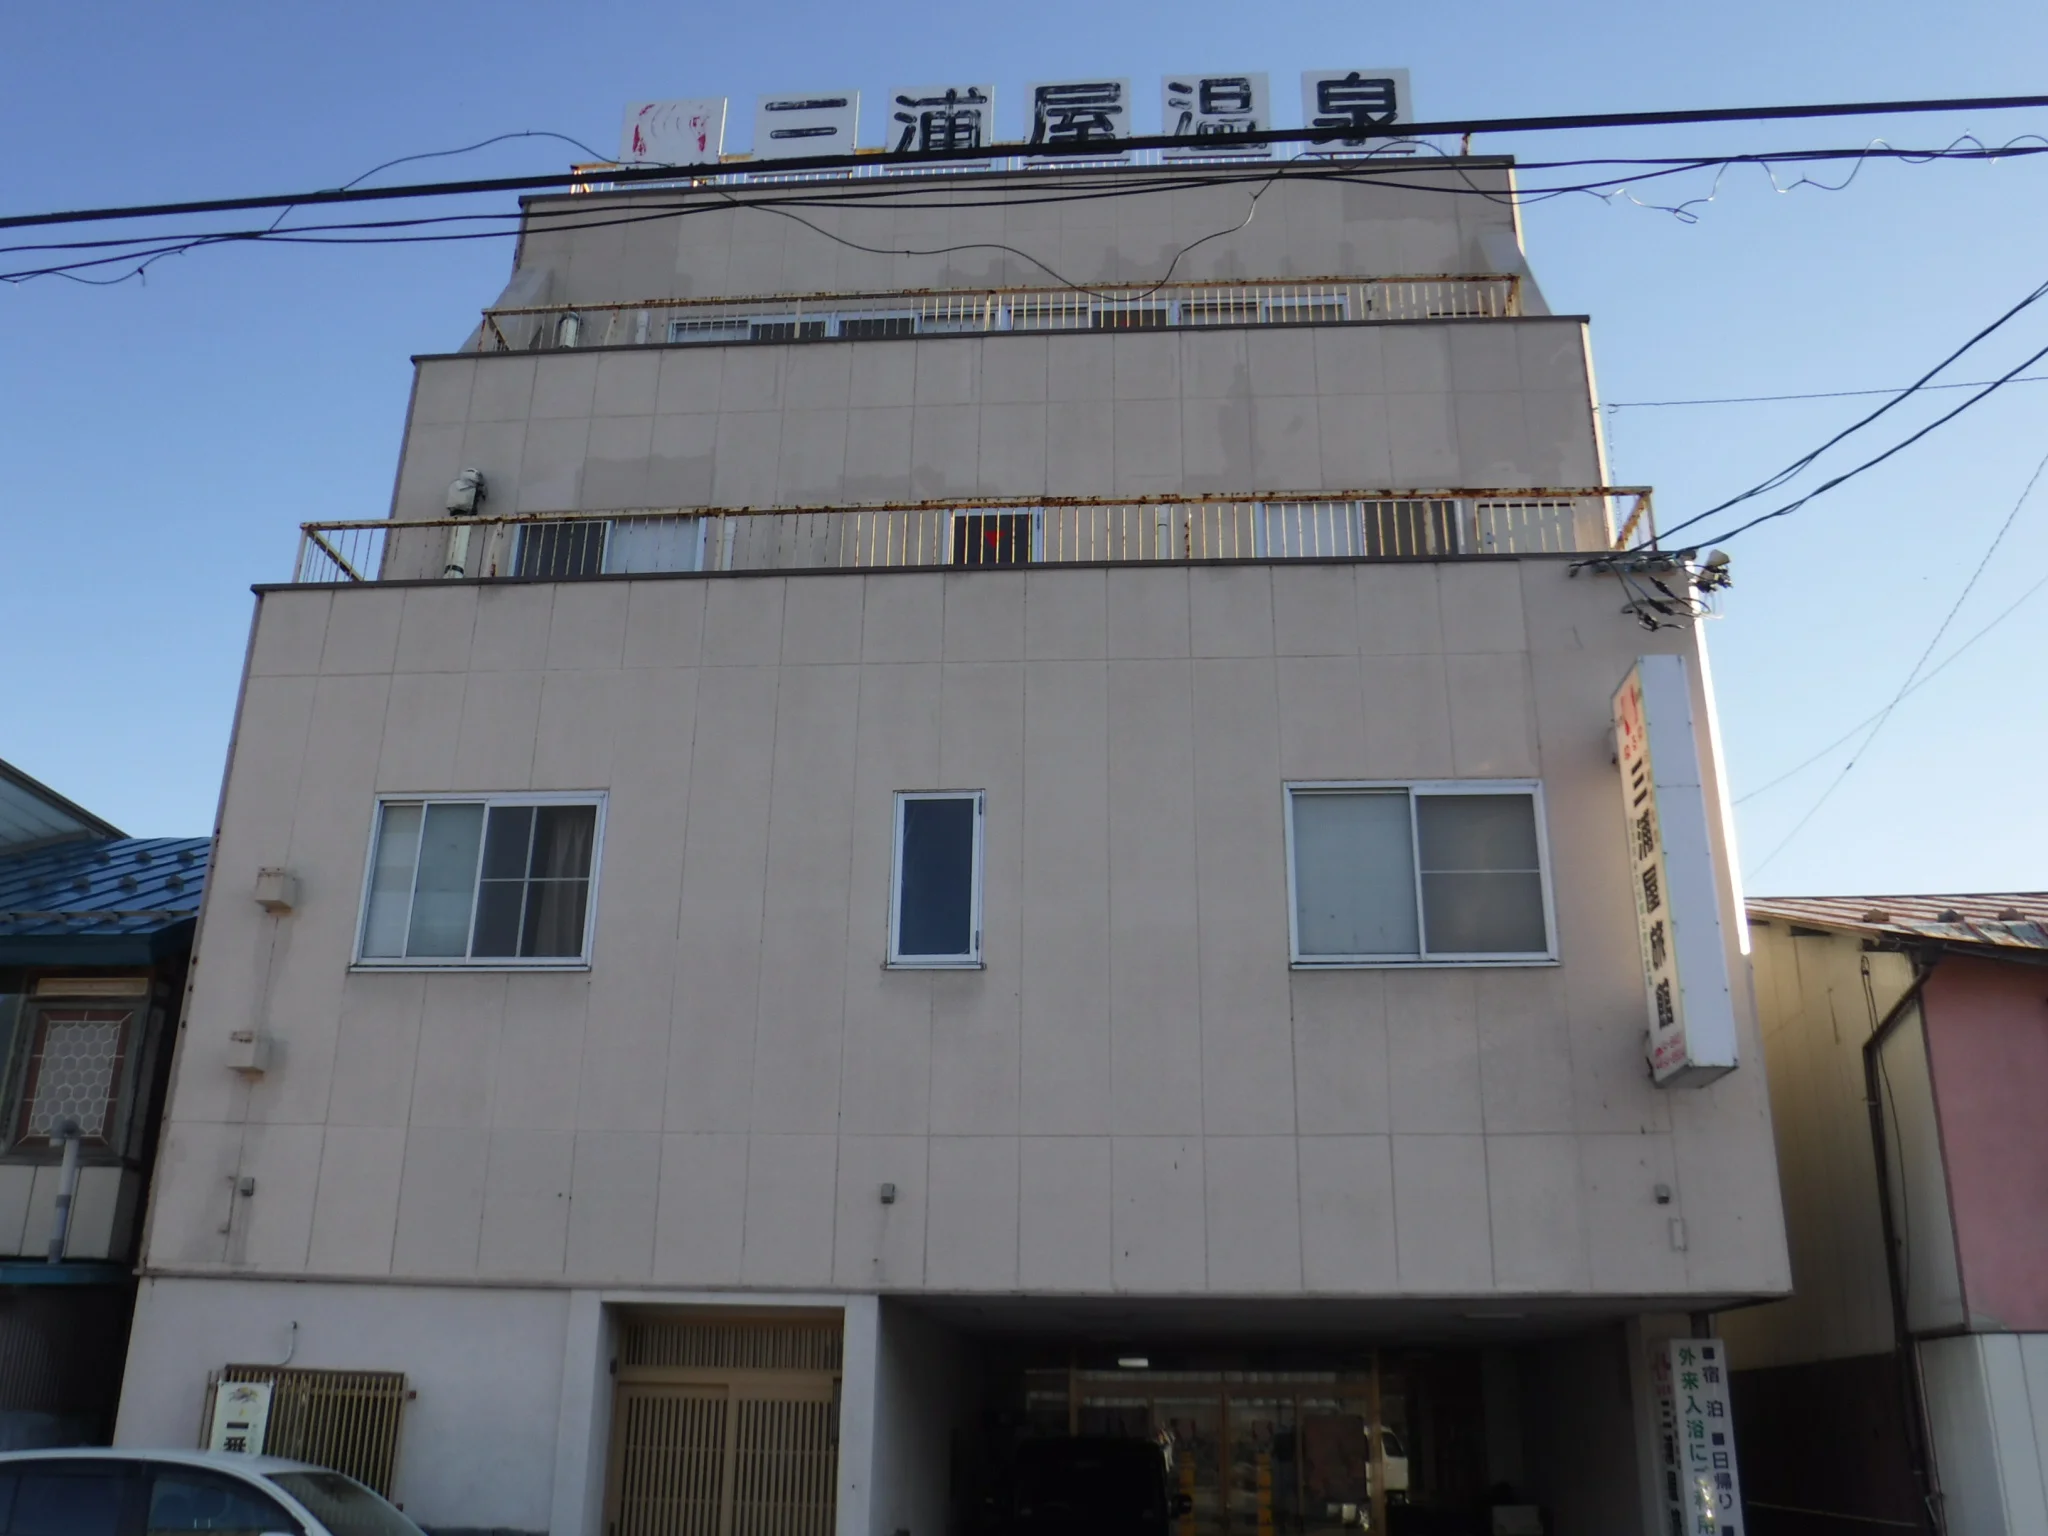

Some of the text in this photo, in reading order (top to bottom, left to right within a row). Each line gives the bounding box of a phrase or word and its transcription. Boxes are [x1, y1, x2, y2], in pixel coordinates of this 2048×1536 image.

[764, 71, 1398, 158] 三浦屋温泉
[1702, 1366, 1733, 1510] 宿泊 日帰り
